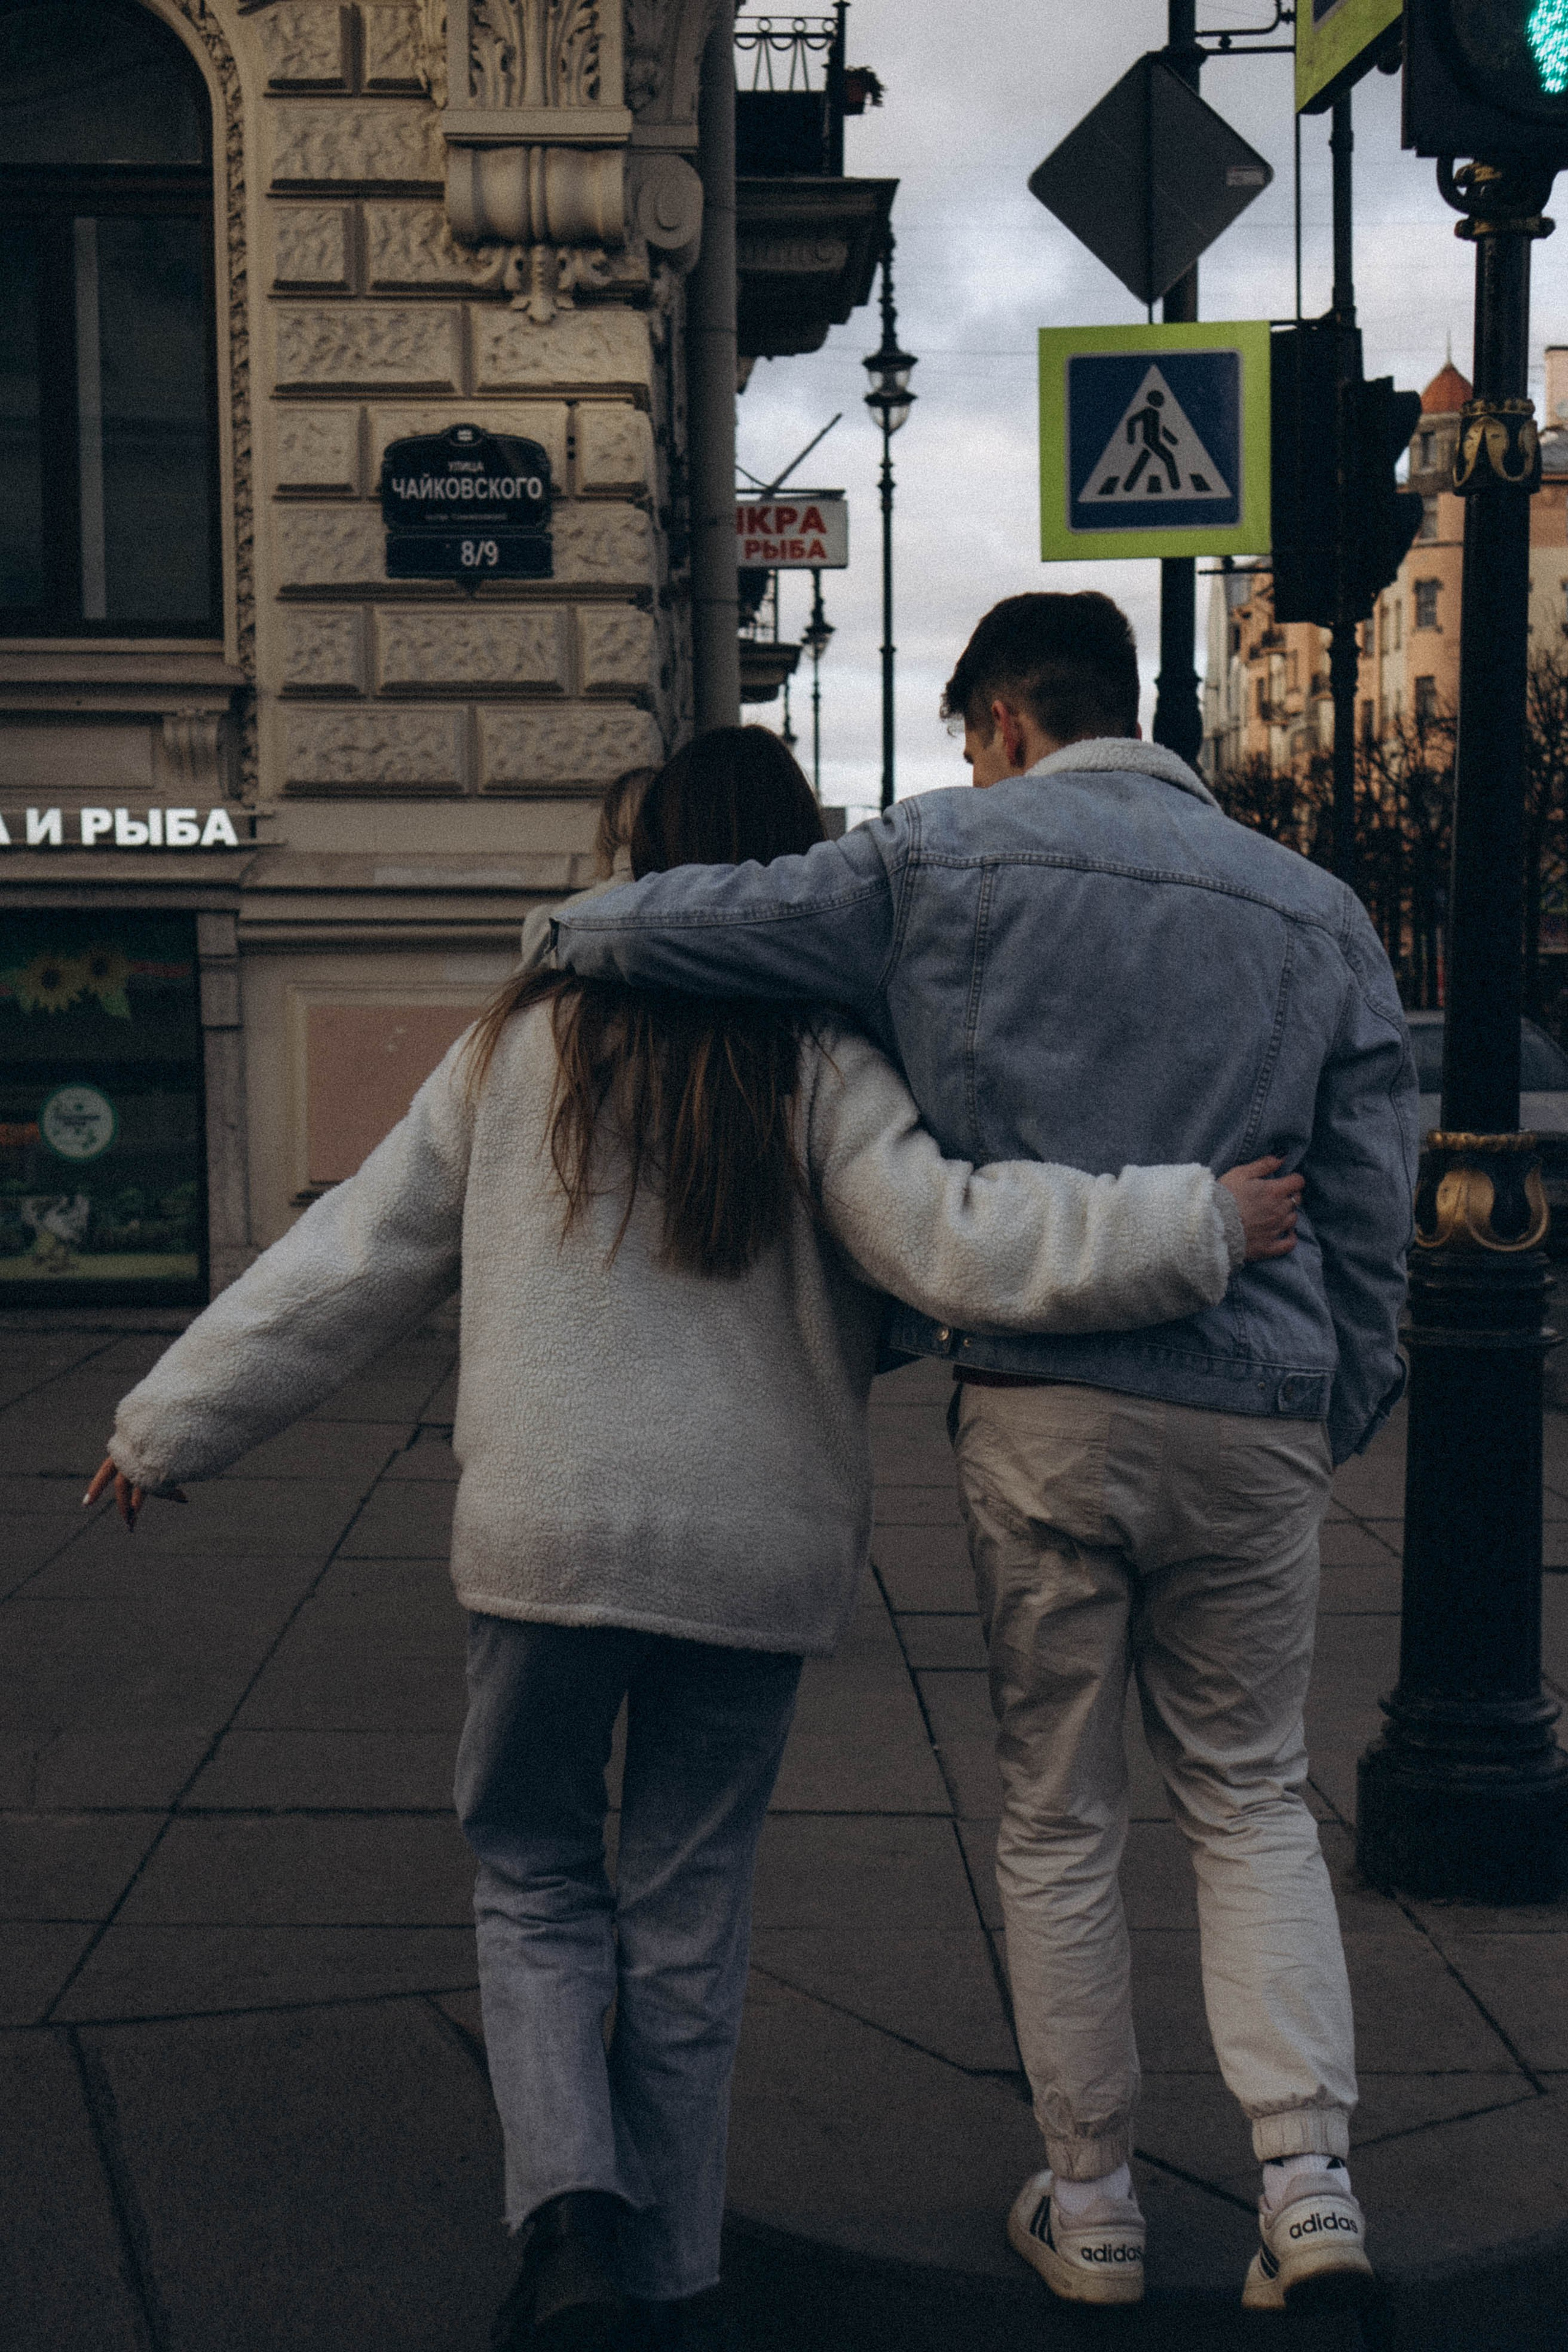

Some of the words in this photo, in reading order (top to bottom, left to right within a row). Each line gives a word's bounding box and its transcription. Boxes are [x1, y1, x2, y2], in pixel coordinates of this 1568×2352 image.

[393, 473, 543, 500] ЧАЙКОВСКОГО
[461, 540, 499, 566] 8/9
[744, 538, 827, 560] РЫБА
[26, 807, 62, 845] И
[80, 807, 239, 846] РЫБА
[1289, 2212, 1358, 2239] adidas
